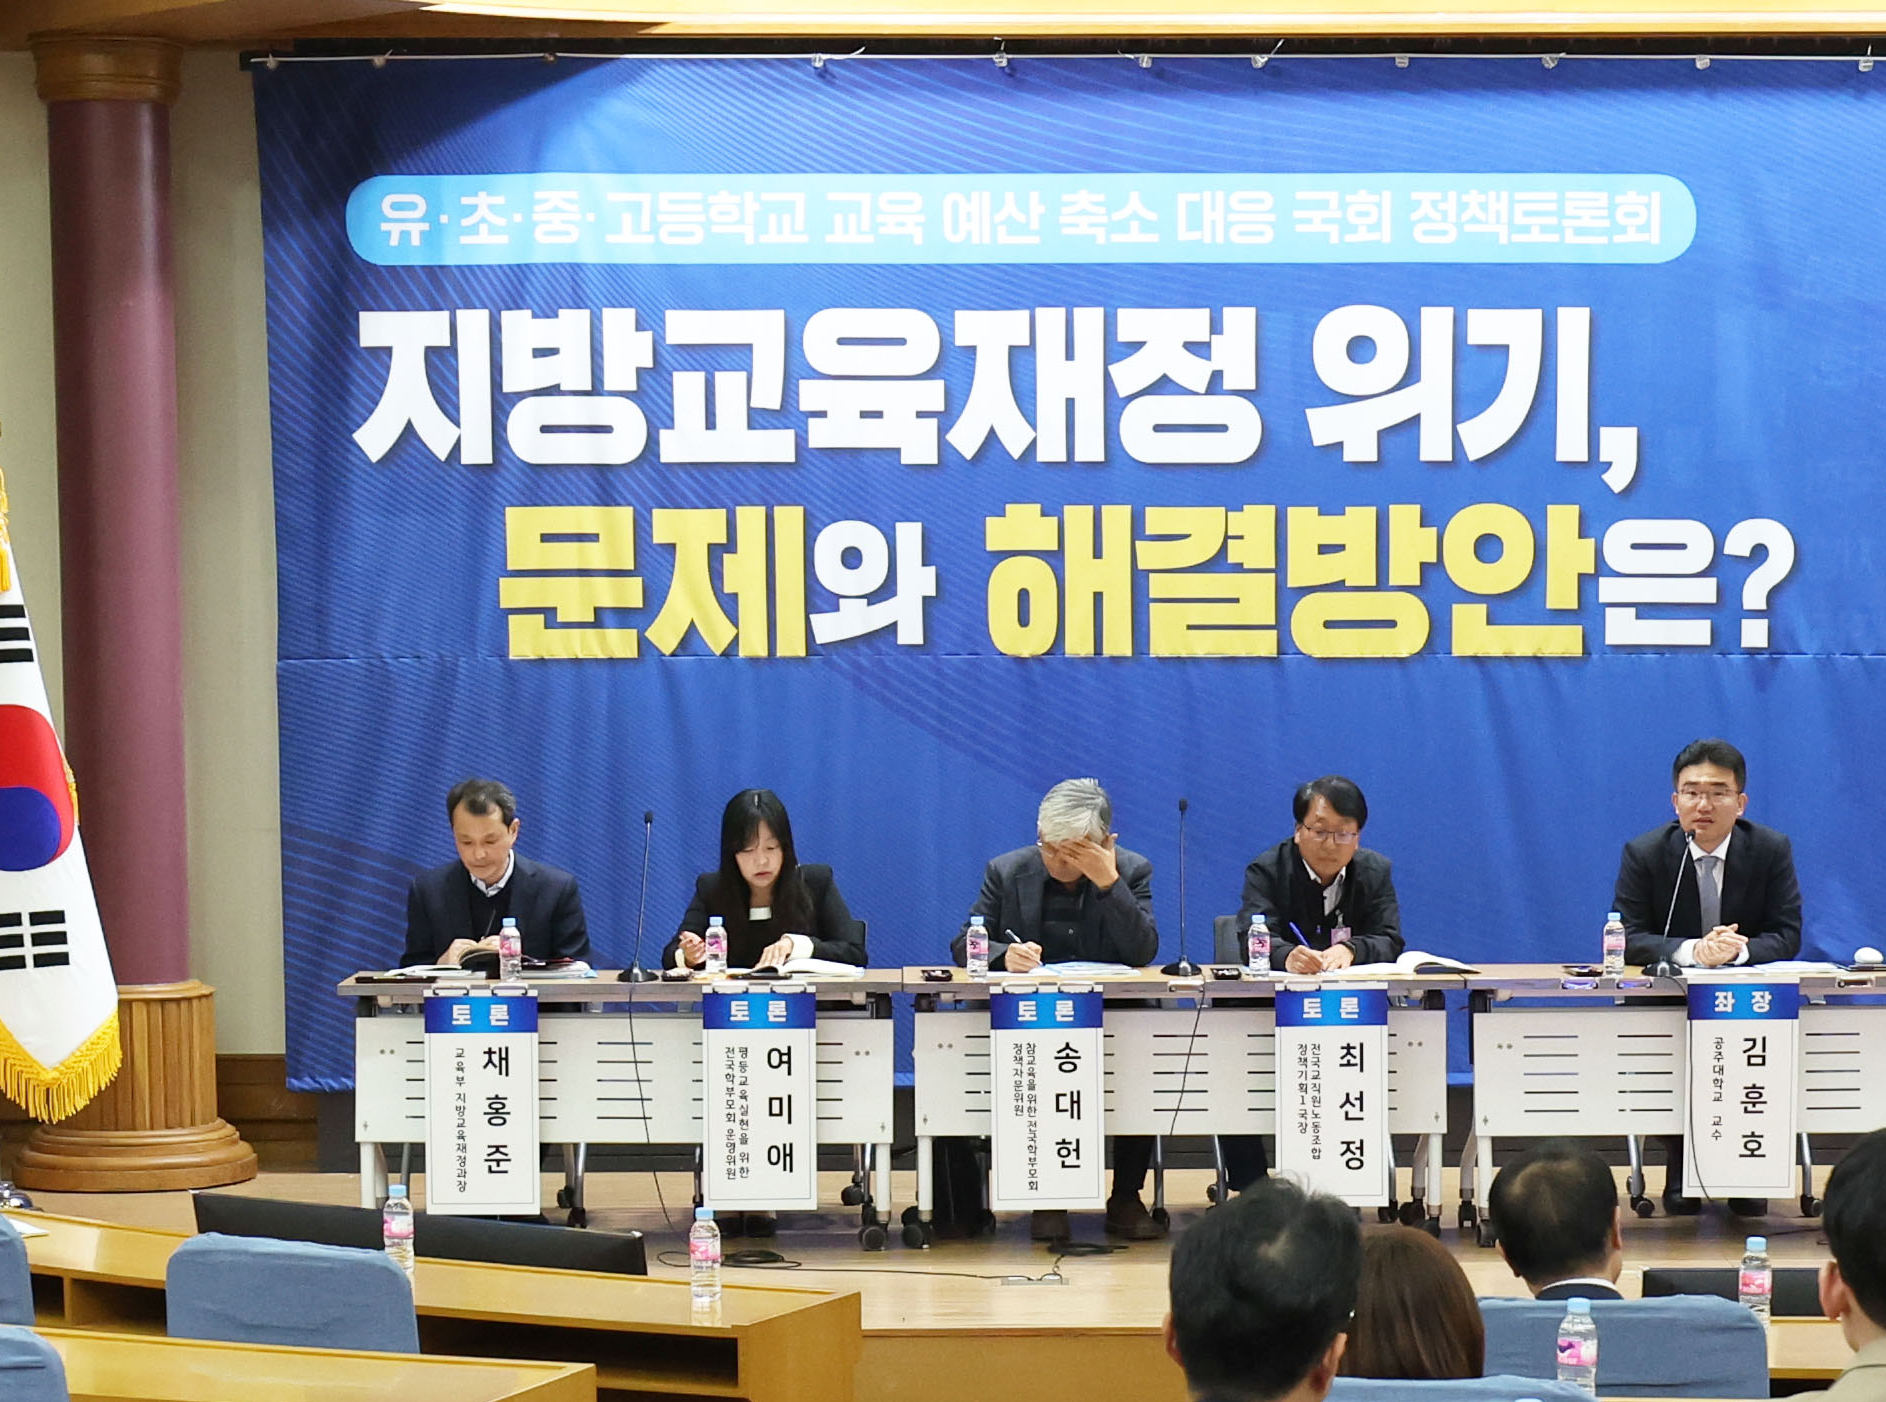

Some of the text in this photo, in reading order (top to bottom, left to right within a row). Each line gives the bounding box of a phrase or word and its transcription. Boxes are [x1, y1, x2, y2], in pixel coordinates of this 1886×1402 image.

[824, 190, 925, 246] 교육
[941, 190, 1045, 246] 예산
[1057, 190, 1161, 246] 축소
[1175, 190, 1277, 246] 대응
[1291, 190, 1393, 246] 국회
[1409, 190, 1662, 246] 정책토론회
[352, 304, 1638, 494] 지방교육재정 위기,
[498, 502, 1795, 660] 문제와 해결방안은?
[451, 1004, 509, 1026] 토론
[730, 1000, 787, 1022] 토론
[1017, 1000, 1075, 1022] 토론
[1302, 997, 1360, 1019] 토론
[1714, 991, 1772, 1013] 좌장
[454, 1047, 466, 1088] 교육부
[482, 1046, 512, 1175] 채홍준
[767, 1045, 794, 1174] 여미애
[1053, 1041, 1082, 1169] 송대헌
[1338, 1042, 1365, 1171] 최선정
[1711, 1036, 1725, 1141] 공주대학교 교수
[1738, 1035, 1768, 1158] 김훈호
